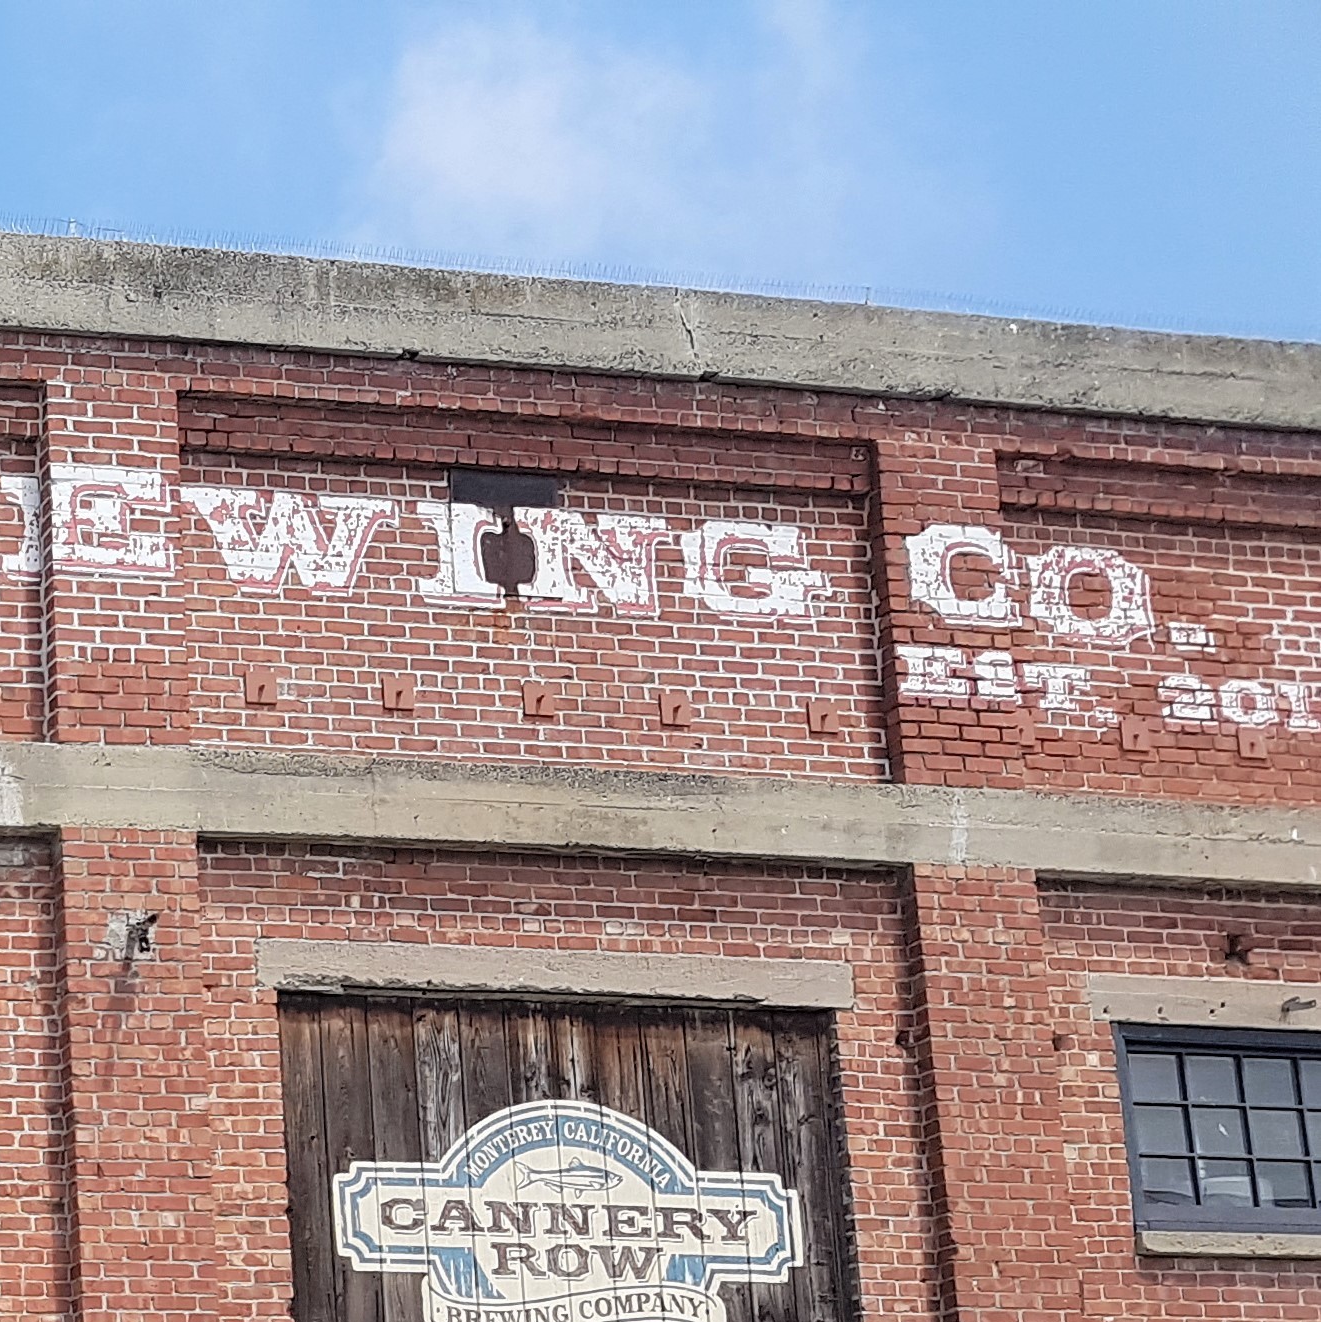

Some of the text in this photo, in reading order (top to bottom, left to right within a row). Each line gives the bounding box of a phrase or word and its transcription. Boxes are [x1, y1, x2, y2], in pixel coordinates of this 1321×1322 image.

[563, 1120, 672, 1189] CALIFORNIA
[380, 1197, 759, 1244] CANNERY
[490, 1242, 664, 1282] ROW
[578, 1290, 707, 1321] COMPANY
